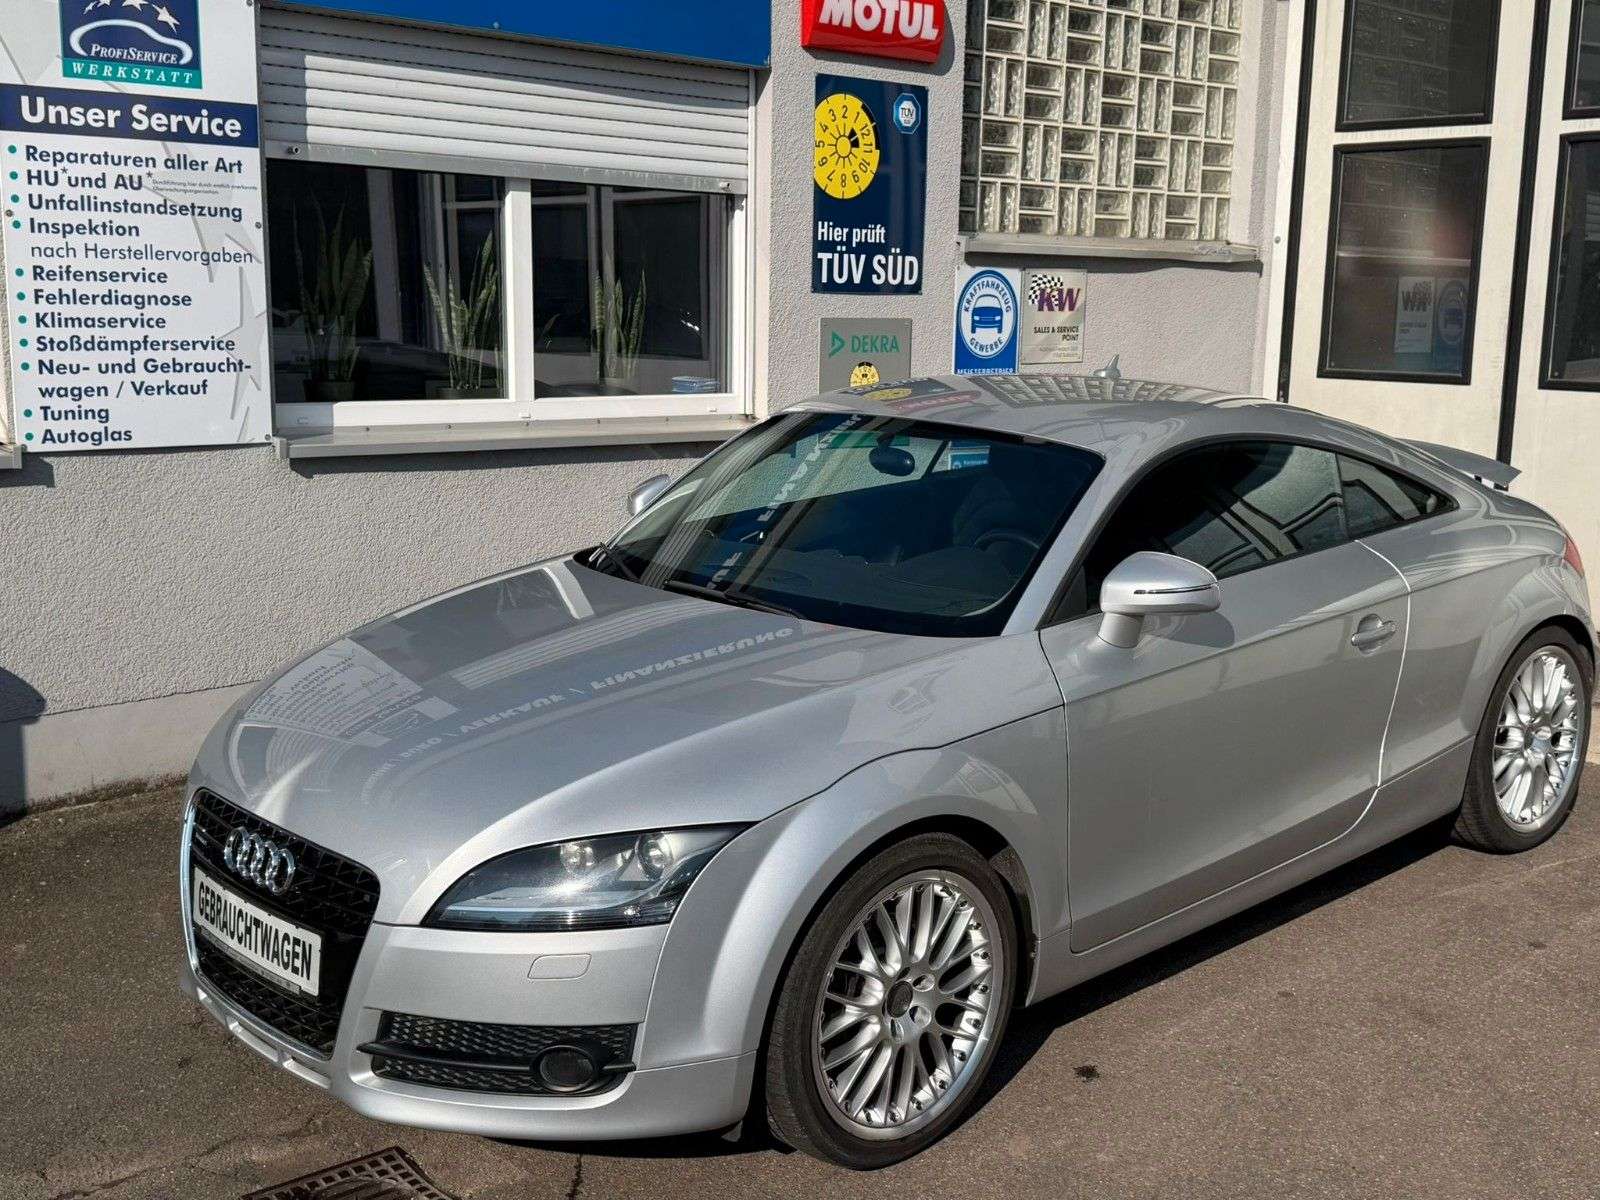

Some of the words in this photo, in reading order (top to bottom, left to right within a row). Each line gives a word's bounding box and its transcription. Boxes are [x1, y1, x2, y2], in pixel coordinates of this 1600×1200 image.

[818, 0, 940, 41] MOTUL
[72, 62, 194, 84] WERKSTATT
[20, 95, 121, 128] Unser
[132, 104, 242, 138] Service
[828, 108, 836, 122] 3
[842, 105, 848, 118] 2
[26, 144, 156, 168] Reparaturen
[164, 154, 208, 172] aller
[214, 157, 243, 174] Art
[68, 172, 107, 189] und
[840, 174, 847, 188] 8
[28, 193, 243, 222] Unfallinstandsetzung
[30, 217, 140, 239] Inspektion
[817, 221, 848, 242] Hier
[852, 224, 886, 248] prüft
[31, 241, 77, 258] nach
[84, 243, 253, 266] Herstellervorgaben
[32, 264, 168, 284] Reifenservice
[817, 246, 867, 285] TÜV
[872, 248, 920, 286] SÜD
[34, 288, 192, 310] Fehlerdiagnose
[964, 280, 1012, 312] KRAFTFAHRZEUG
[1037, 288, 1081, 312] KW
[35, 312, 166, 329] Klimaservice
[36, 335, 236, 354] Stoßdämpferservice
[852, 334, 900, 354] DEKRA
[970, 336, 1004, 353] GEWERBE
[38, 360, 90, 374] Neu-
[98, 358, 136, 374] und
[143, 358, 252, 374] Gebraucht-
[38, 383, 109, 402] wagen
[116, 380, 124, 398] /
[130, 380, 208, 396] Verkauf
[40, 404, 110, 424] Tuning
[41, 426, 132, 446] Autoglas
[198, 880, 312, 981] GEBRAUCHTWAGEN
